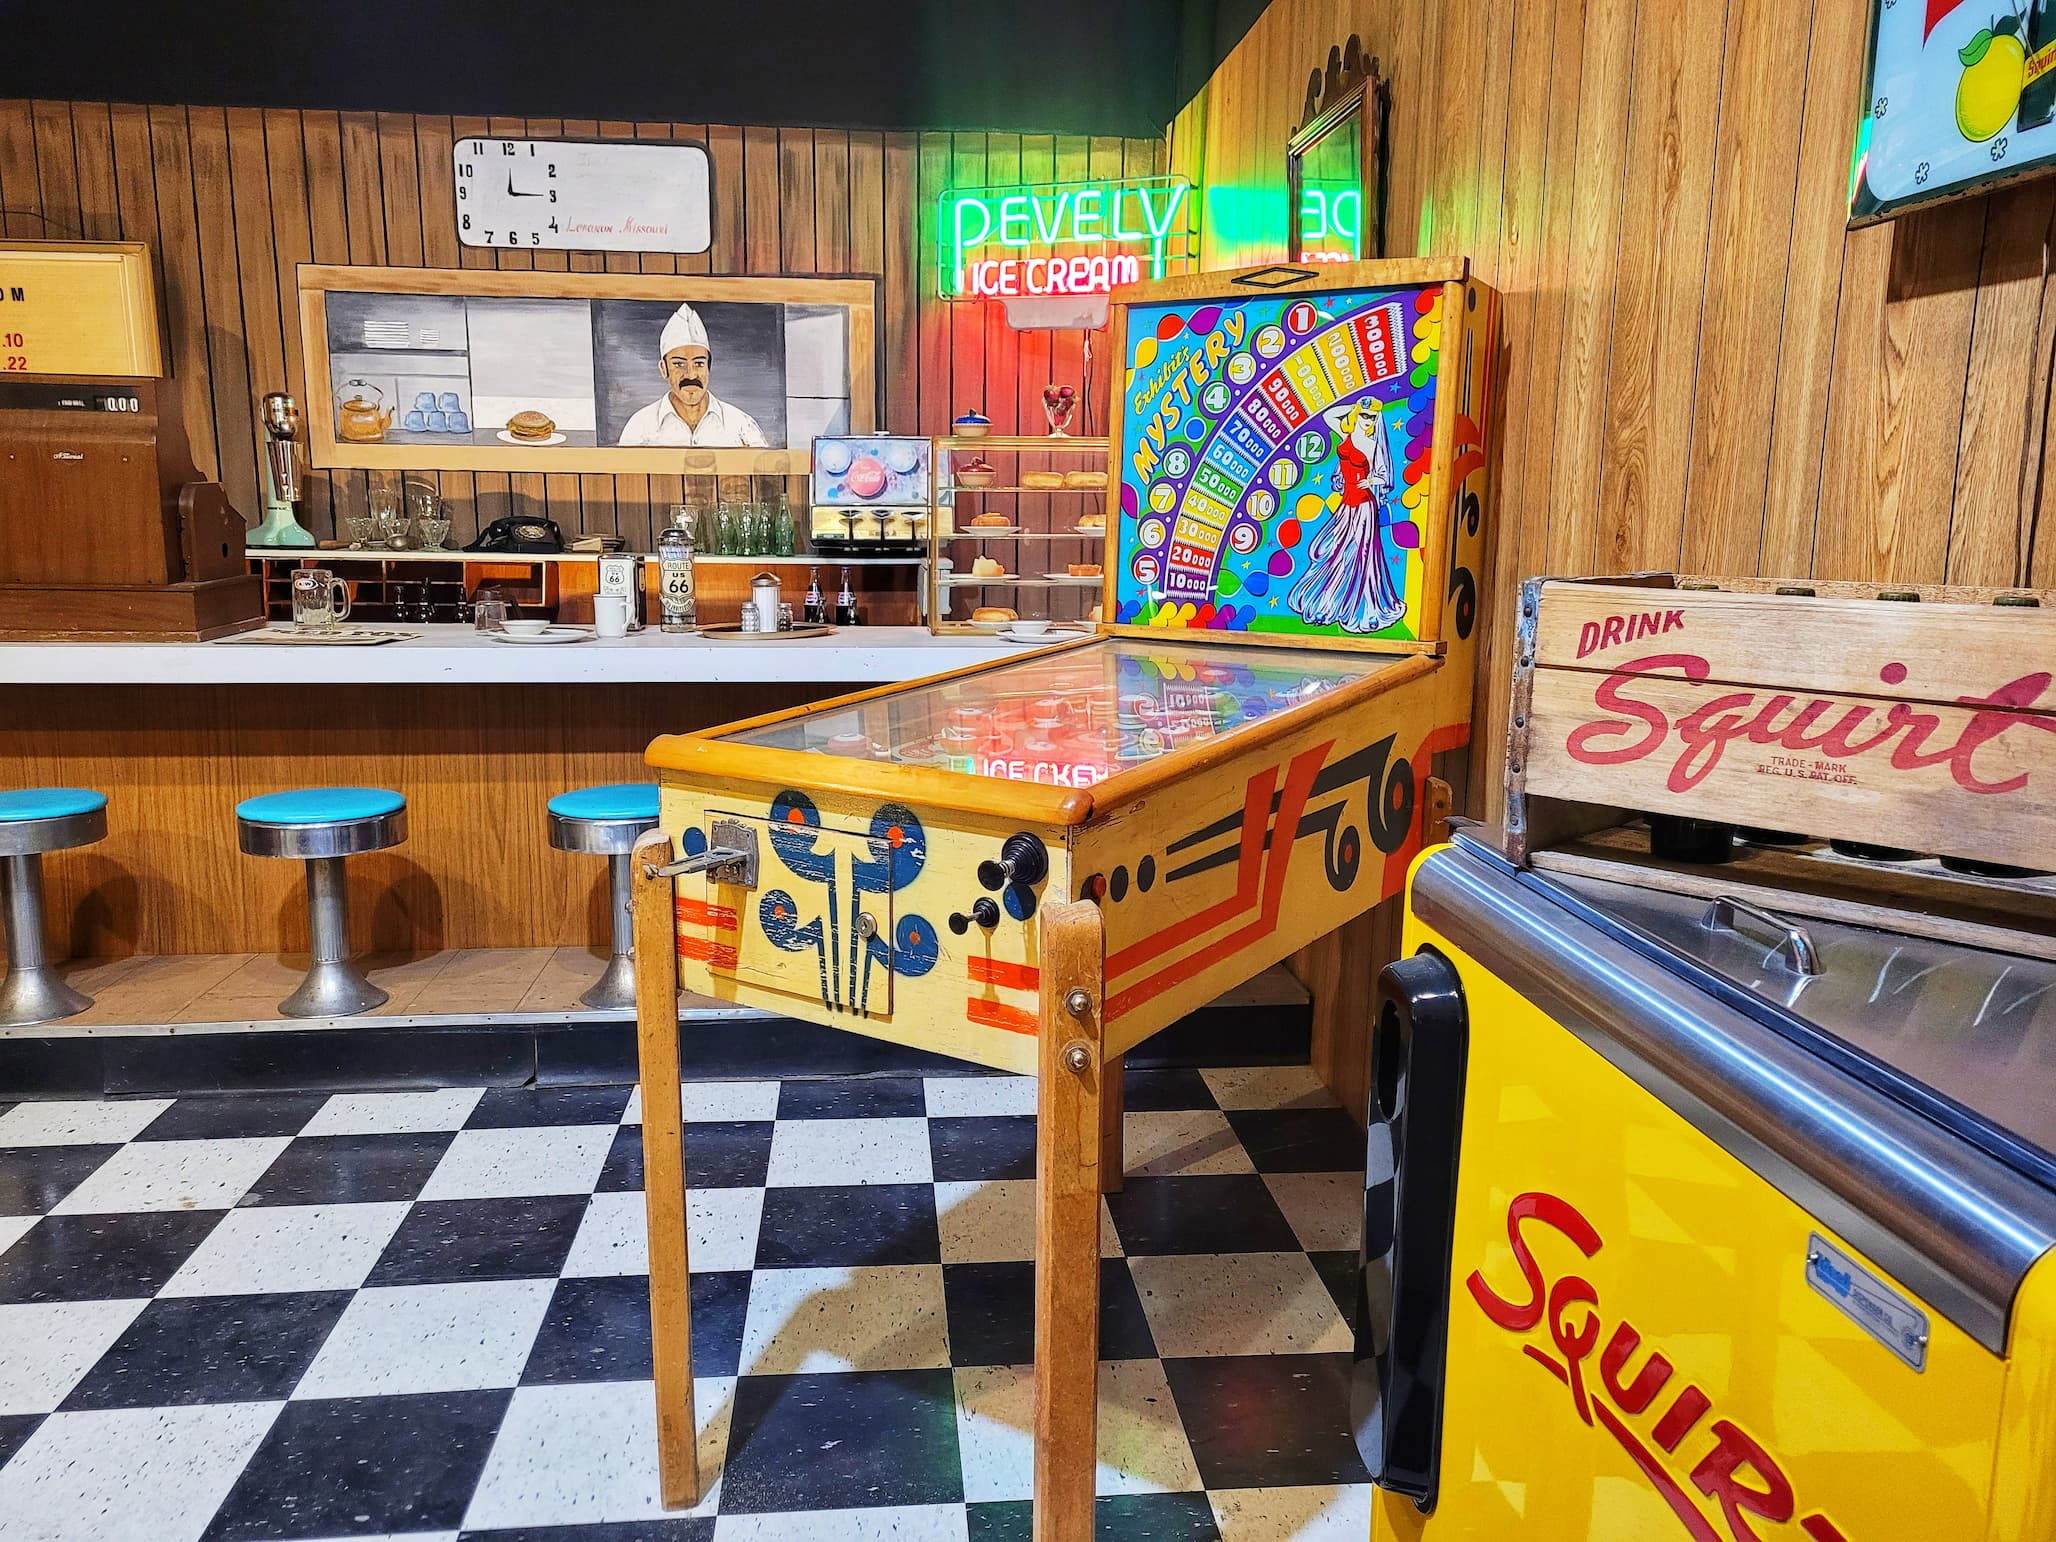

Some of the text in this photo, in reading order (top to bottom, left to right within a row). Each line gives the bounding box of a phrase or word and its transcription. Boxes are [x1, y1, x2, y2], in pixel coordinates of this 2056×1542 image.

[473, 143, 483, 155] 11
[503, 143, 515, 156] 12
[530, 144, 535, 156] 1
[459, 164, 473, 178] 10
[549, 164, 556, 178] 2
[460, 187, 467, 200] 9
[550, 191, 557, 203] 3
[463, 215, 471, 230] 8
[549, 216, 559, 234] 4
[485, 231, 494, 244] 7
[509, 231, 518, 245] 6
[532, 233, 540, 245] 5
[955, 182, 1188, 294] PEVELY
[972, 254, 1139, 296] ICE CREAM
[1296, 306, 1310, 332] 1
[1261, 330, 1281, 354] 2
[1364, 314, 1389, 378] 300000
[1232, 357, 1253, 382] 3
[1132, 310, 1247, 486] MYSTERY
[1205, 386, 1227, 409] 4
[1268, 377, 1300, 422] 90000
[1247, 398, 1282, 440] 80000
[1228, 420, 1265, 458] 70000
[1300, 435, 1322, 459] 12
[1167, 451, 1186, 476] 8
[1212, 443, 1250, 479] 60000
[1199, 467, 1238, 500] 50000
[1272, 463, 1294, 487] 11
[1153, 487, 1172, 510] 7
[1187, 494, 1226, 522] 40000
[1250, 493, 1271, 517] 10
[1143, 522, 1161, 546] 6
[1178, 519, 1218, 544] 30000
[1235, 527, 1253, 550] 9
[667, 562, 689, 570] ROUTE
[1171, 546, 1212, 569] 20000
[609, 575, 621, 583] 66
[1138, 560, 1156, 583] 5
[1169, 572, 1207, 591] 10000
[669, 579, 689, 594] 66
[1576, 608, 1686, 660] DRINK
[1566, 652, 2056, 796] Squirt
[1466, 1192, 1848, 1542] SQUIR
